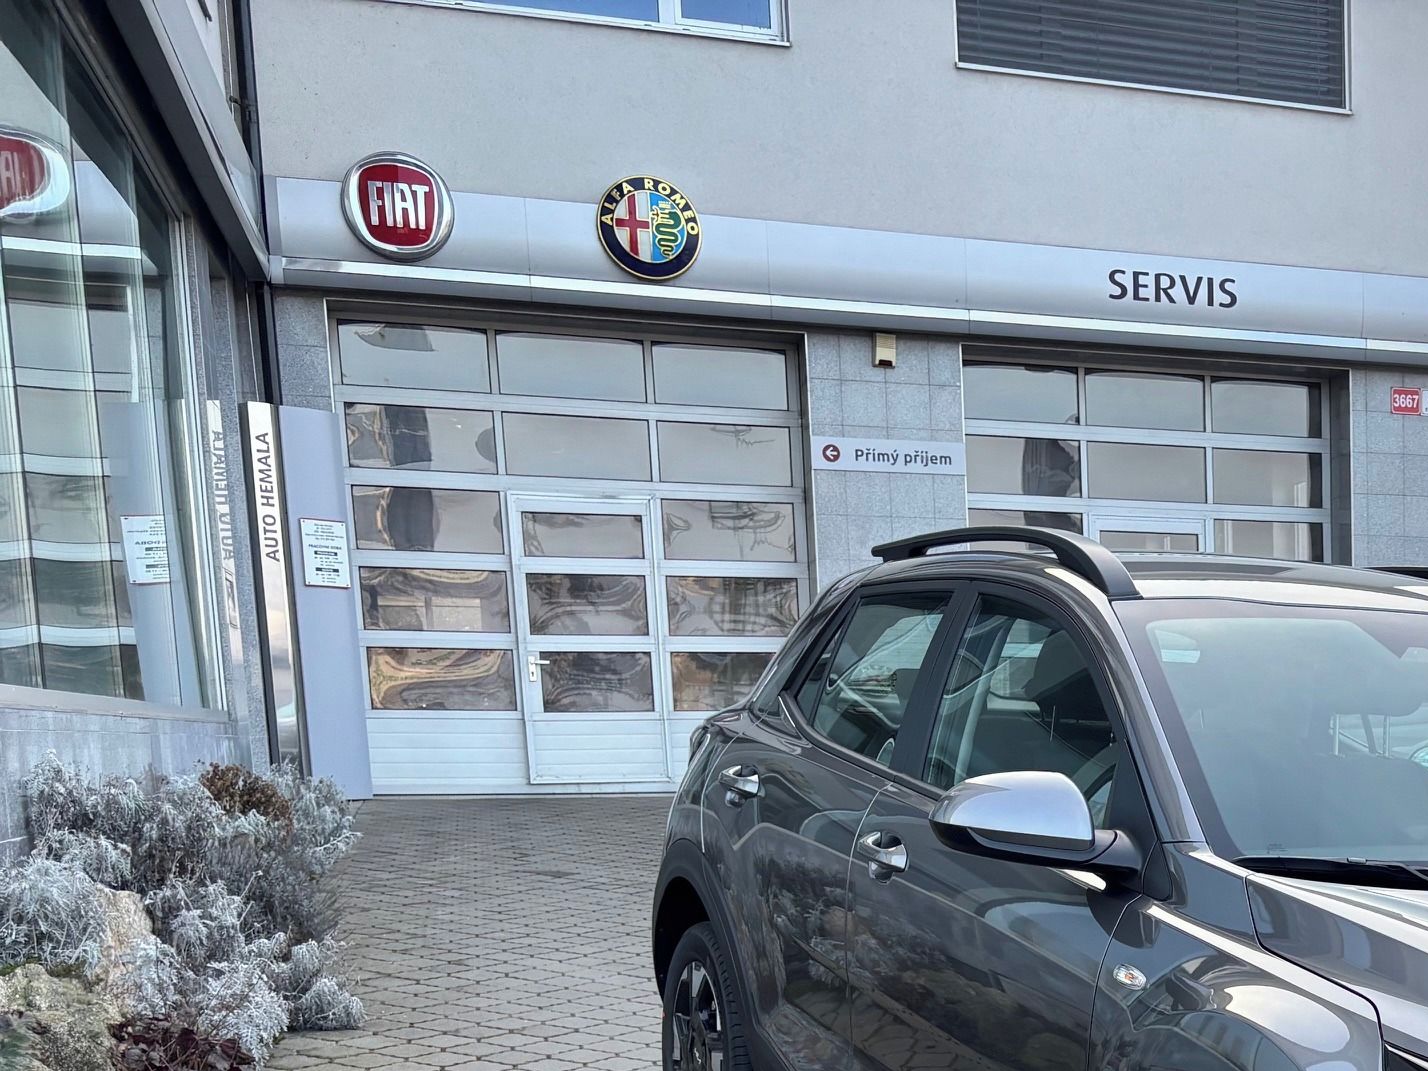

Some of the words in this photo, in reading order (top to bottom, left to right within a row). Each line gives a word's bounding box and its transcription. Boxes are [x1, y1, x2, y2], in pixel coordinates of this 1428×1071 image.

[368, 180, 429, 230] FIAT
[601, 182, 635, 226] ALFA
[643, 178, 699, 235] ROMEO
[1108, 269, 1238, 309] SERVIS
[1393, 394, 1419, 408] 3667
[255, 432, 276, 508] HEMALA
[854, 447, 899, 466] Přímý
[904, 449, 953, 467] příjem
[262, 513, 281, 563] AUTO
